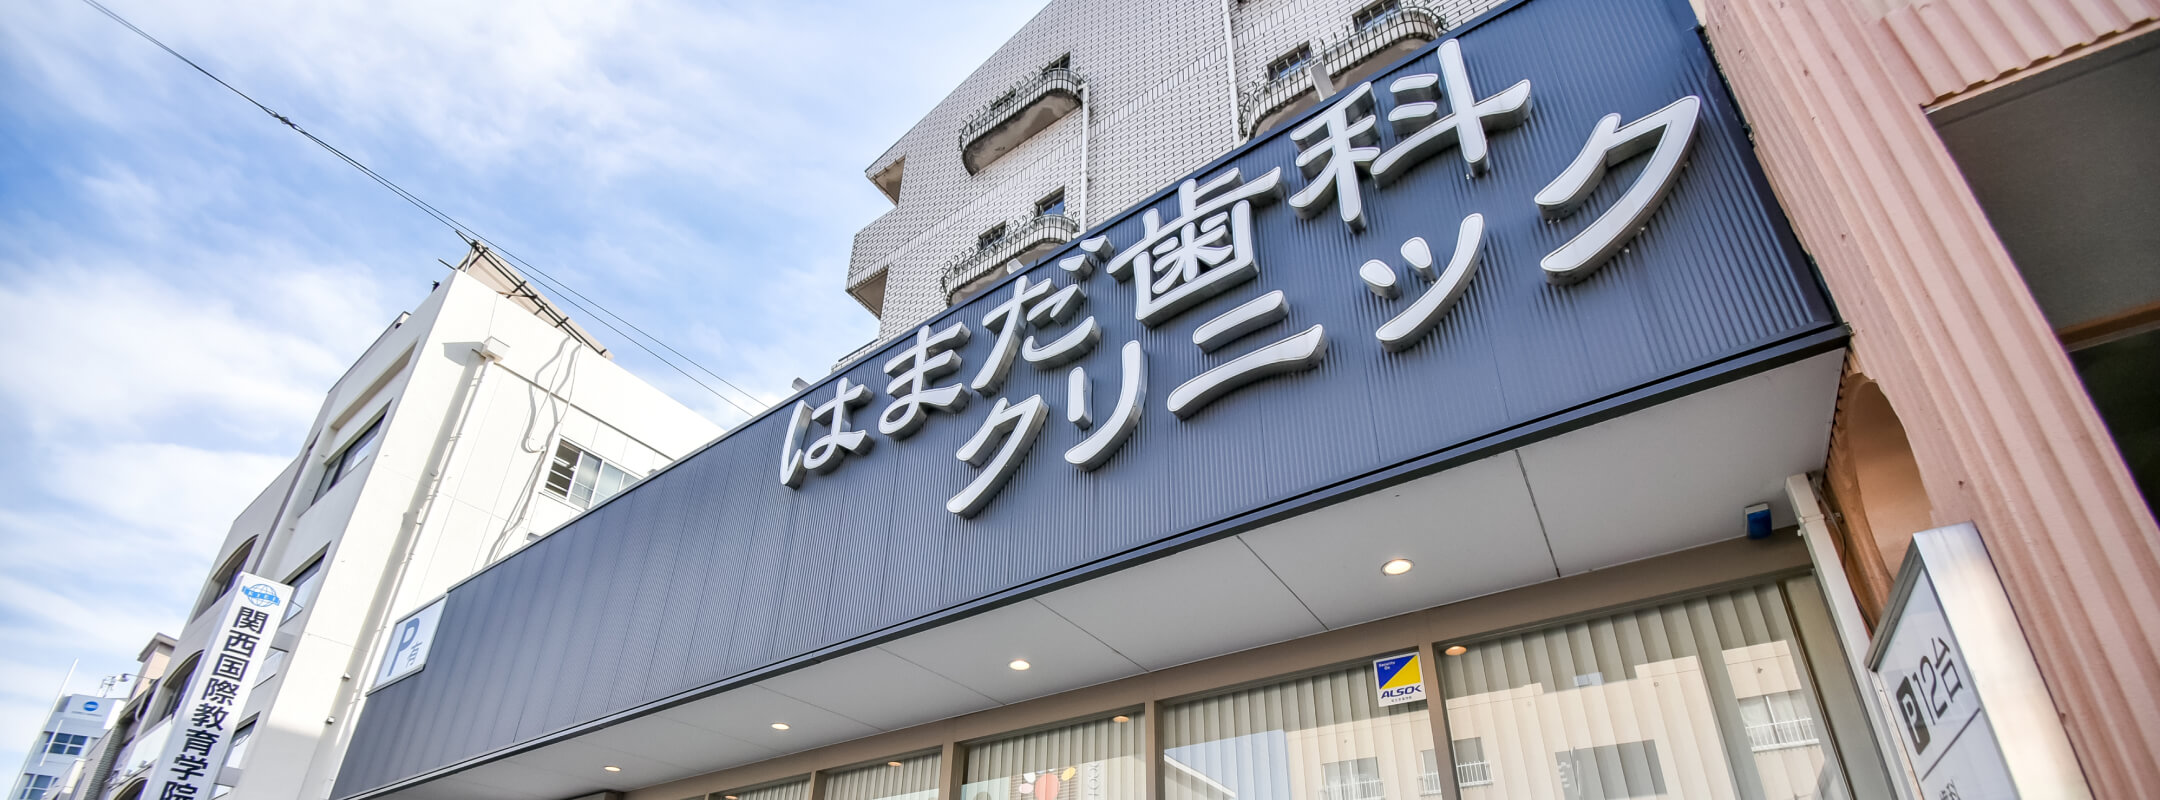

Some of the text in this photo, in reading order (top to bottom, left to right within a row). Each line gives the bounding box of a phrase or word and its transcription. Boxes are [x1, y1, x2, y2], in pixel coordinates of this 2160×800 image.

[780, 38, 1531, 488] はまだ歯科
[946, 96, 1702, 518] クリニック
[387, 617, 420, 677] P
[1381, 684, 1422, 699] ALSOK
[1912, 636, 1963, 725] 12台
